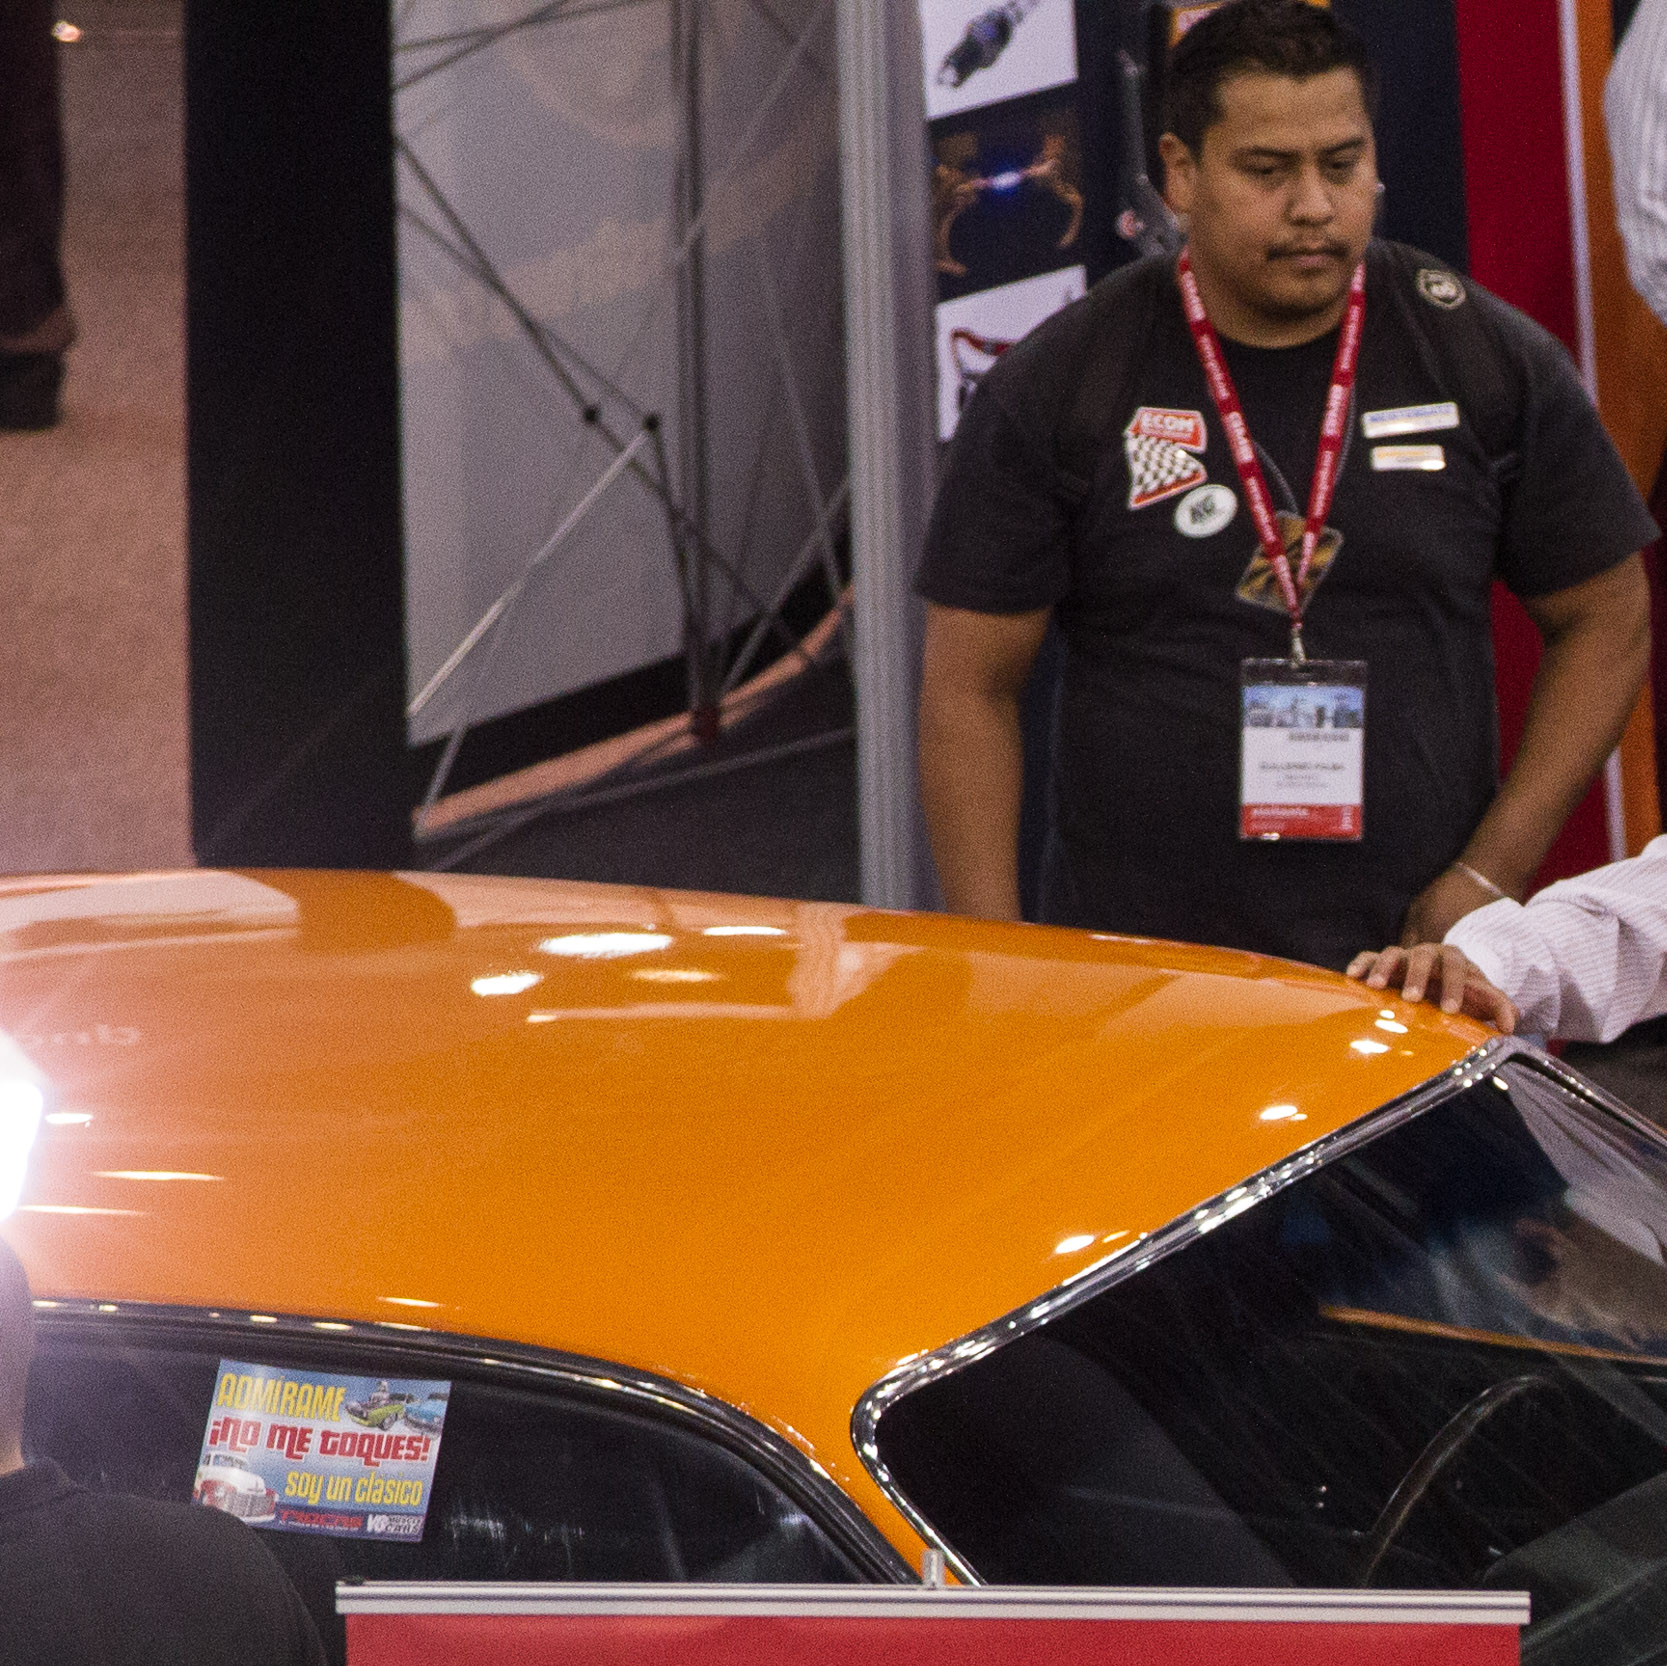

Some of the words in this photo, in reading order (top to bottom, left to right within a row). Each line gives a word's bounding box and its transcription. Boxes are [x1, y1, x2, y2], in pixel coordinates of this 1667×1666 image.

[216, 1373, 347, 1422] ADMÍRAME
[266, 1422, 314, 1461] ME
[284, 1470, 324, 1507] soy
[326, 1476, 353, 1502] un
